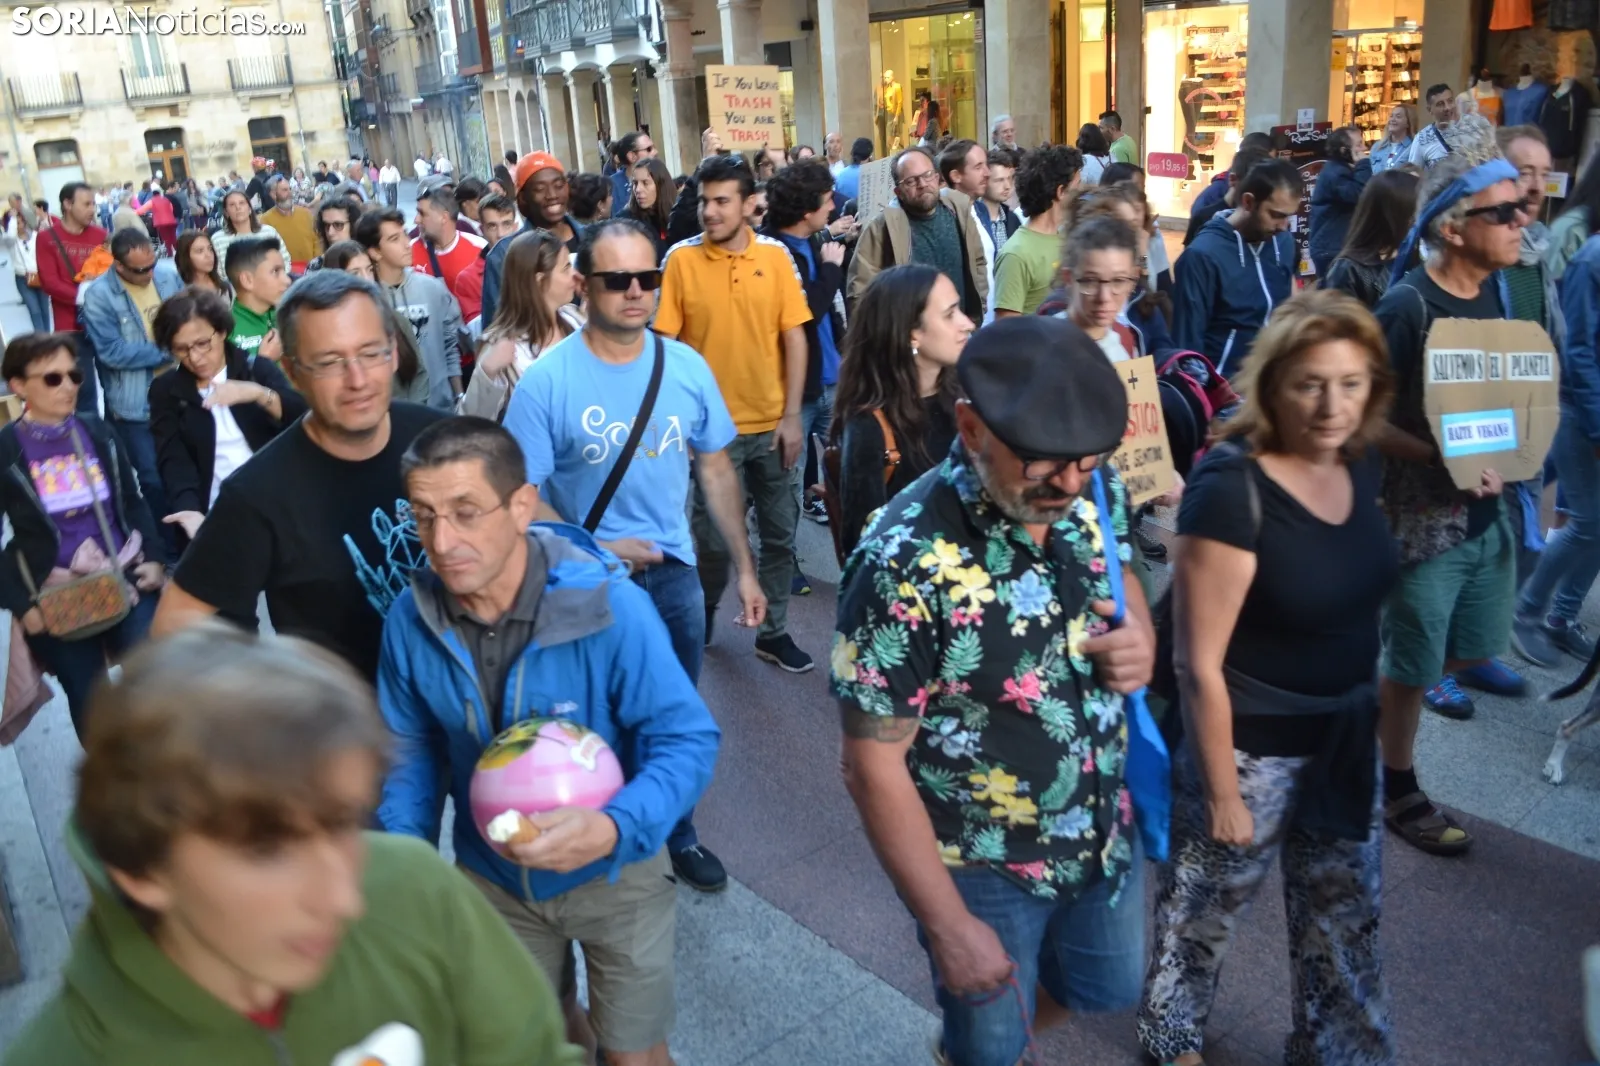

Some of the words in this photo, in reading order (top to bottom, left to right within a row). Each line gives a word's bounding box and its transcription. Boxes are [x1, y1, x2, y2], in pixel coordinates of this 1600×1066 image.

[712, 73, 729, 88] IF
[735, 77, 752, 90] YOU
[724, 94, 772, 108] TRASH
[725, 111, 745, 124] YOU
[753, 115, 775, 124] ARE
[728, 129, 769, 141] TRASH
[1433, 353, 1483, 380] SALVEMOS
[1490, 356, 1499, 377] EL
[1512, 355, 1550, 376] PLANETA
[1123, 402, 1159, 437] STICO
[1447, 425, 1473, 441] HAZTE
